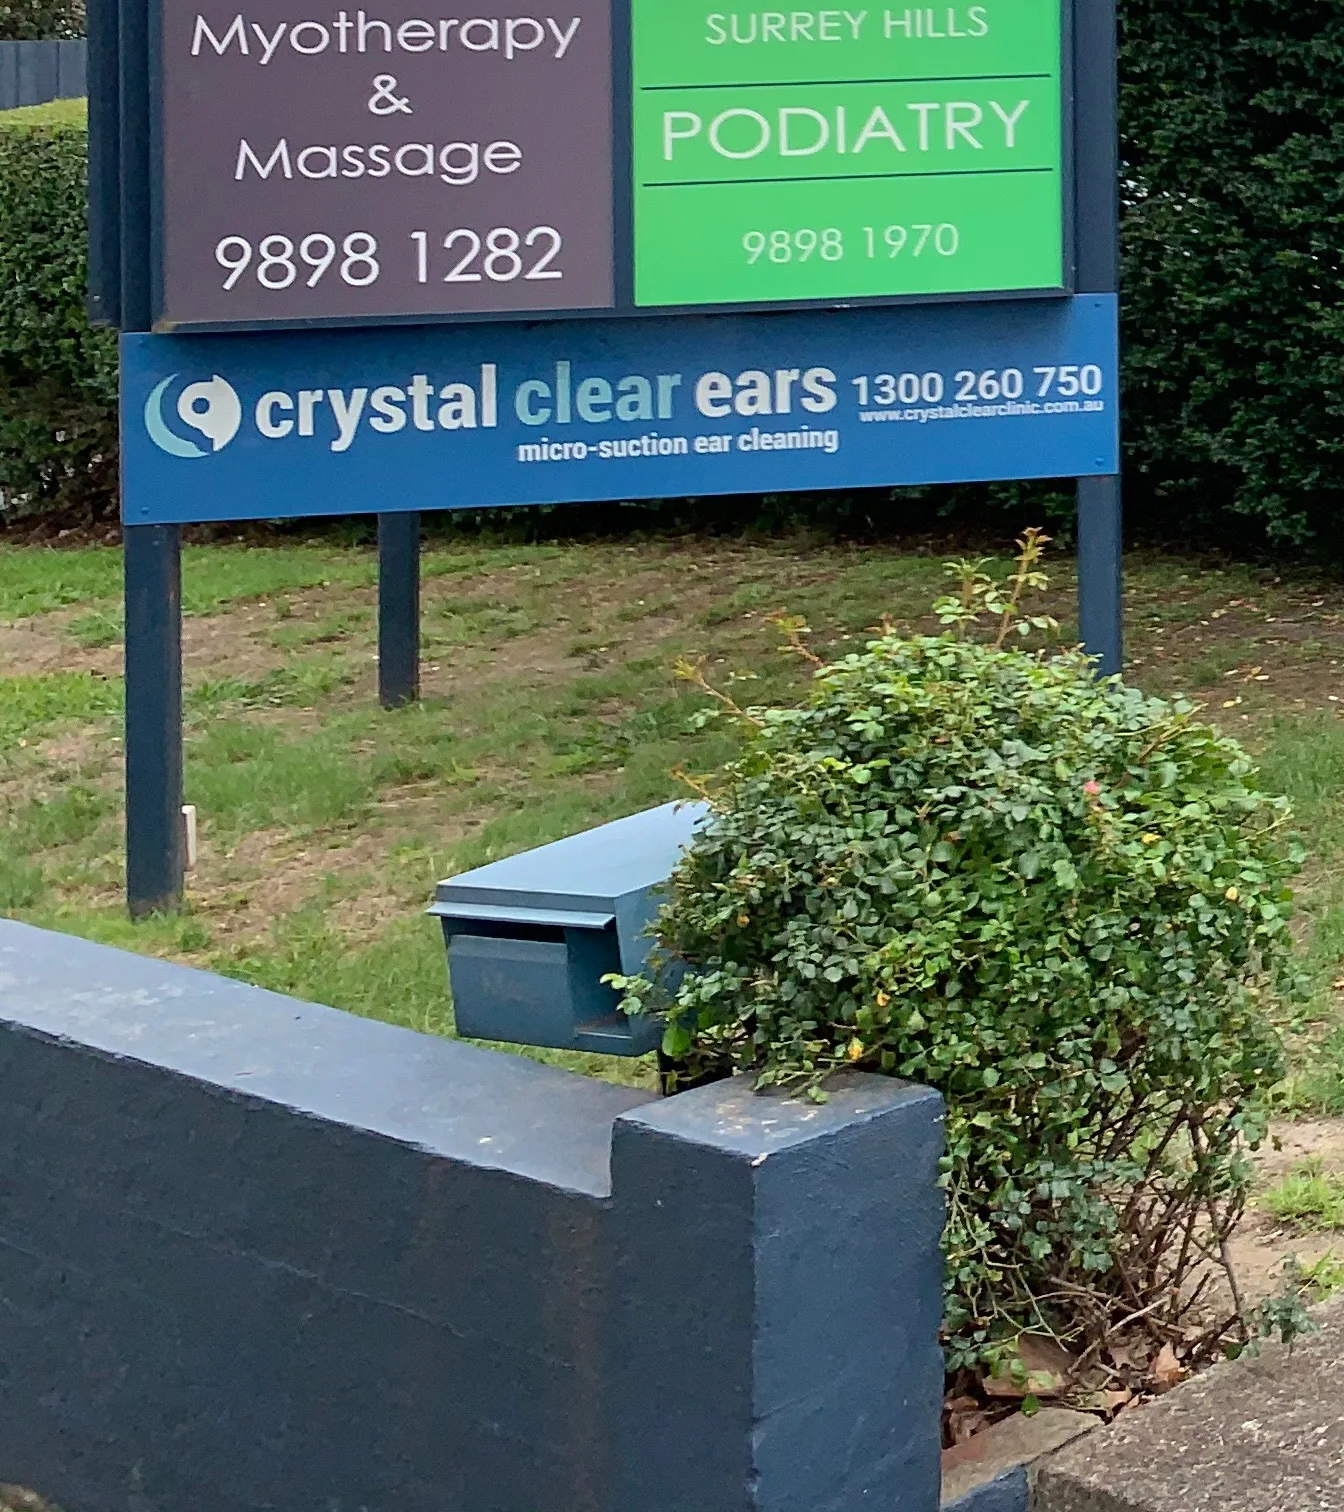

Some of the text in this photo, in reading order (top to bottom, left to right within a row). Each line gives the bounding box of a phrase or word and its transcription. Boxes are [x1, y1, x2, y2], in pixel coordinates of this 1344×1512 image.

[191, 10, 581, 65] Myotherapy
[704, 6, 989, 45] SURREY HILLS
[367, 74, 413, 115] &
[663, 99, 1029, 161] PODIATRY
[234, 138, 523, 185] Massage
[214, 226, 564, 290] 9898 1282
[741, 223, 959, 265] 9898 1970
[255, 360, 838, 452] crystal clear ears
[851, 364, 1102, 406] 1300 260 750
[859, 400, 1104, 423] www.crystalclearclinic.com.au
[518, 427, 839, 463] micro-suction ear cleaning
